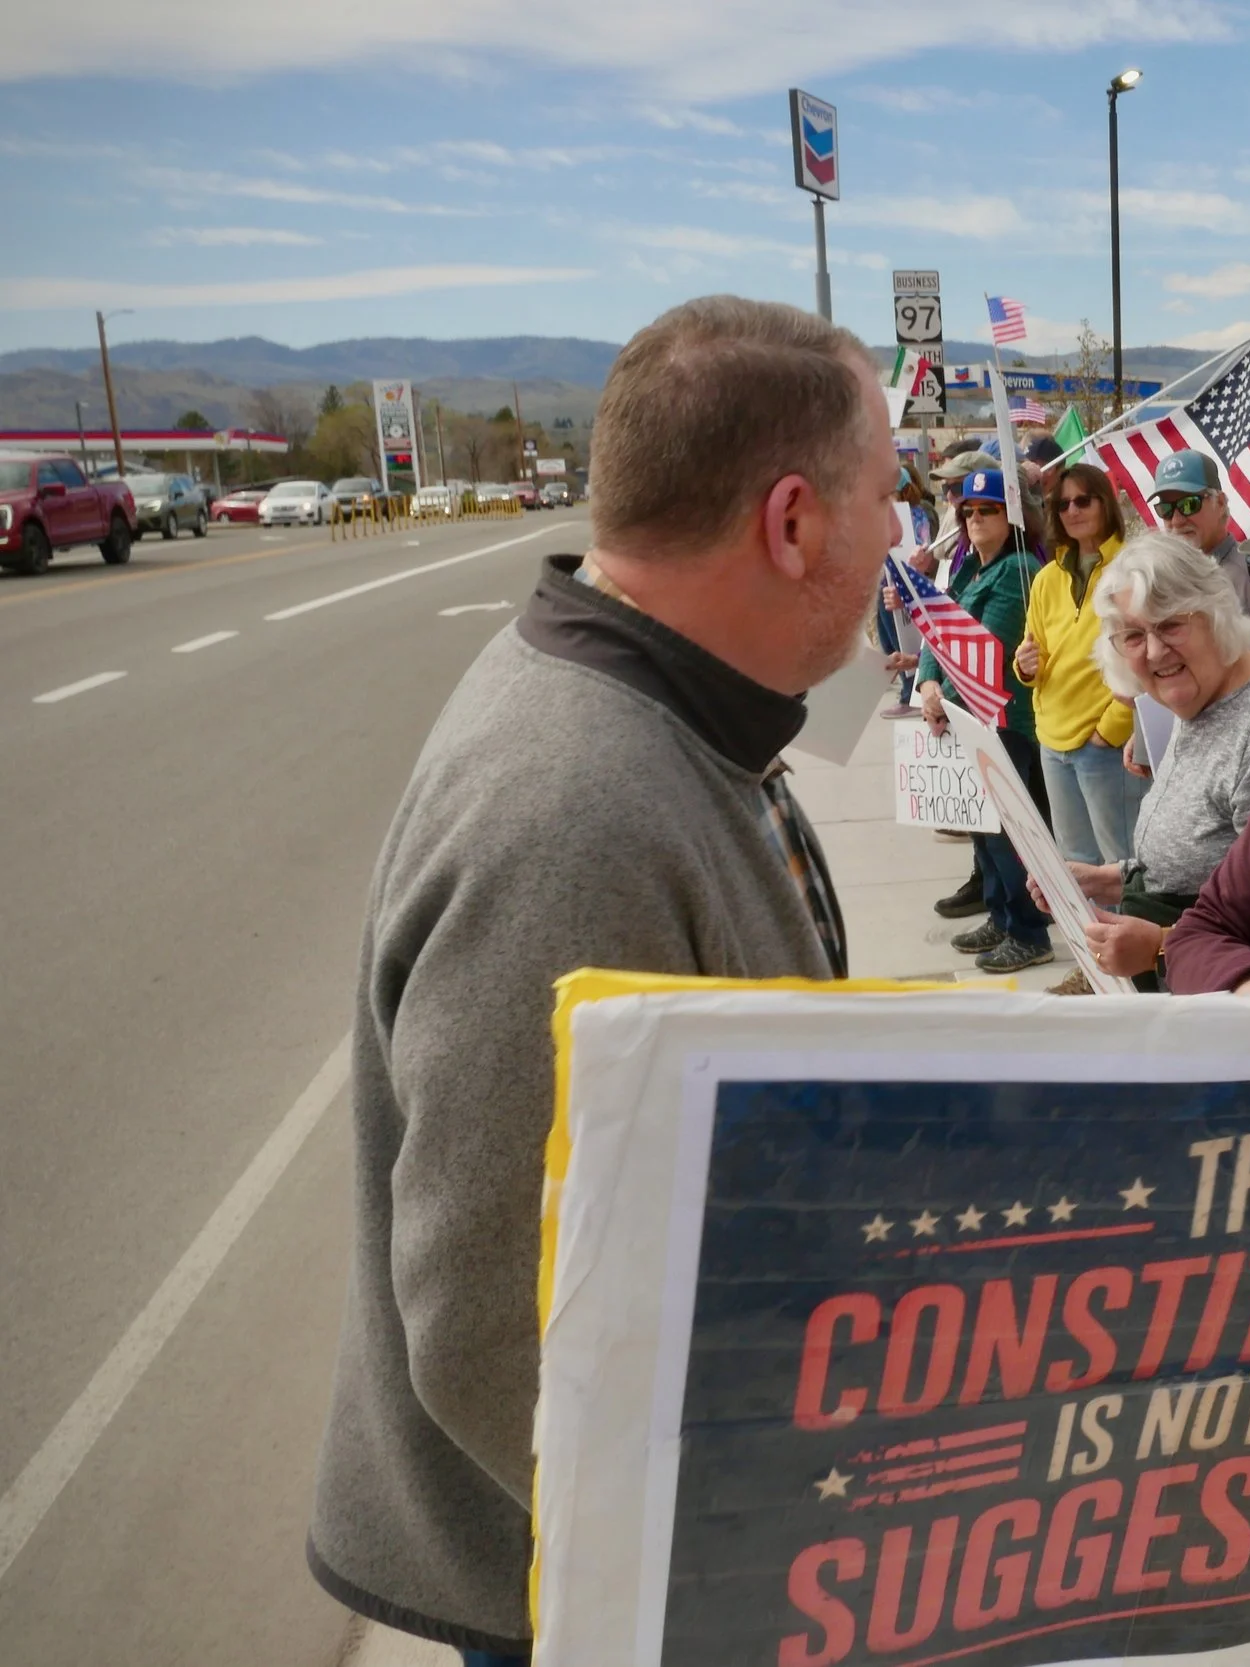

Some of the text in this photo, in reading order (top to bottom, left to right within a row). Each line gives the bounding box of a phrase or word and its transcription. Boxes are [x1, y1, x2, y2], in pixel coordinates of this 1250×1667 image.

[801, 96, 833, 123] Chevron
[895, 275, 938, 289] BUSINESS
[900, 305, 936, 331] 97
[915, 730, 966, 760] DOGE
[911, 795, 985, 827] DEMOCRACY
[1046, 1393, 1120, 1482] IS
